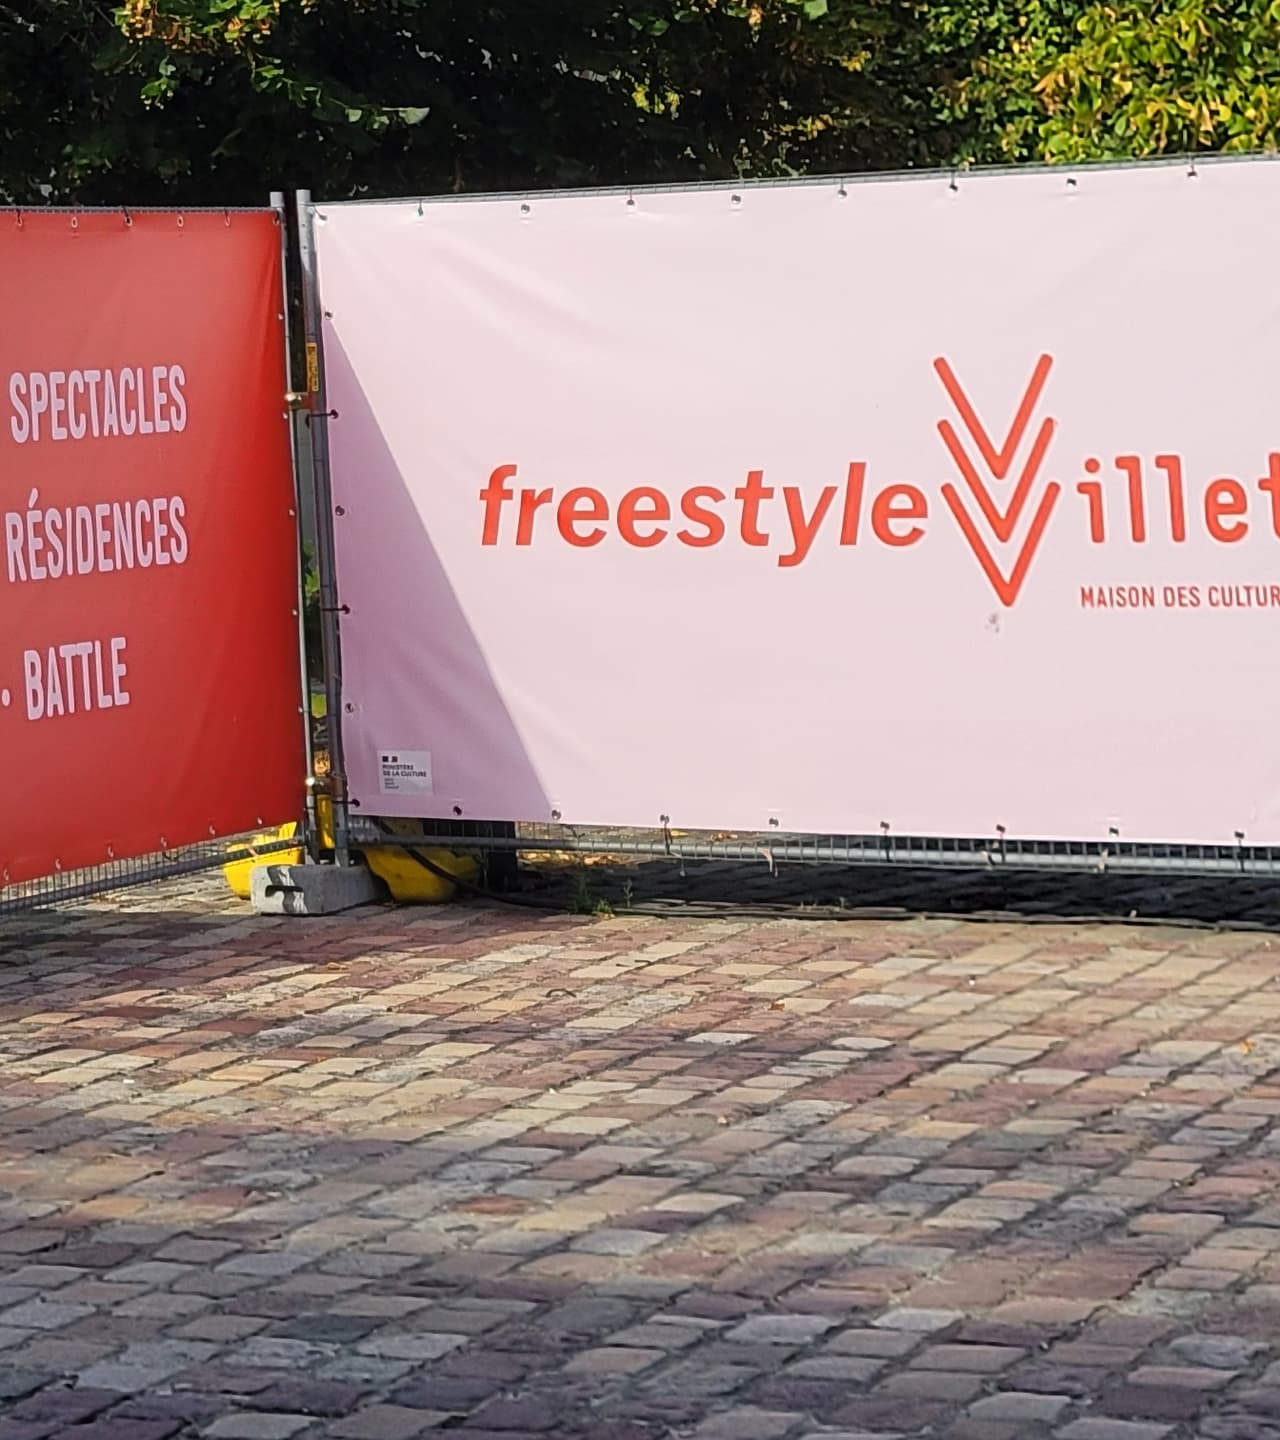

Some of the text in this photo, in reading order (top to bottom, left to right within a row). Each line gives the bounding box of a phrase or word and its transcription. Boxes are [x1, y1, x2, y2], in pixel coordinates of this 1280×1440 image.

[9, 364, 187, 444] SPECTACLES
[5, 487, 188, 583] RÉSIDENCES
[1080, 586, 1155, 608] MAISON
[1164, 586, 1200, 608] DES
[23, 636, 130, 721] BATTLE
